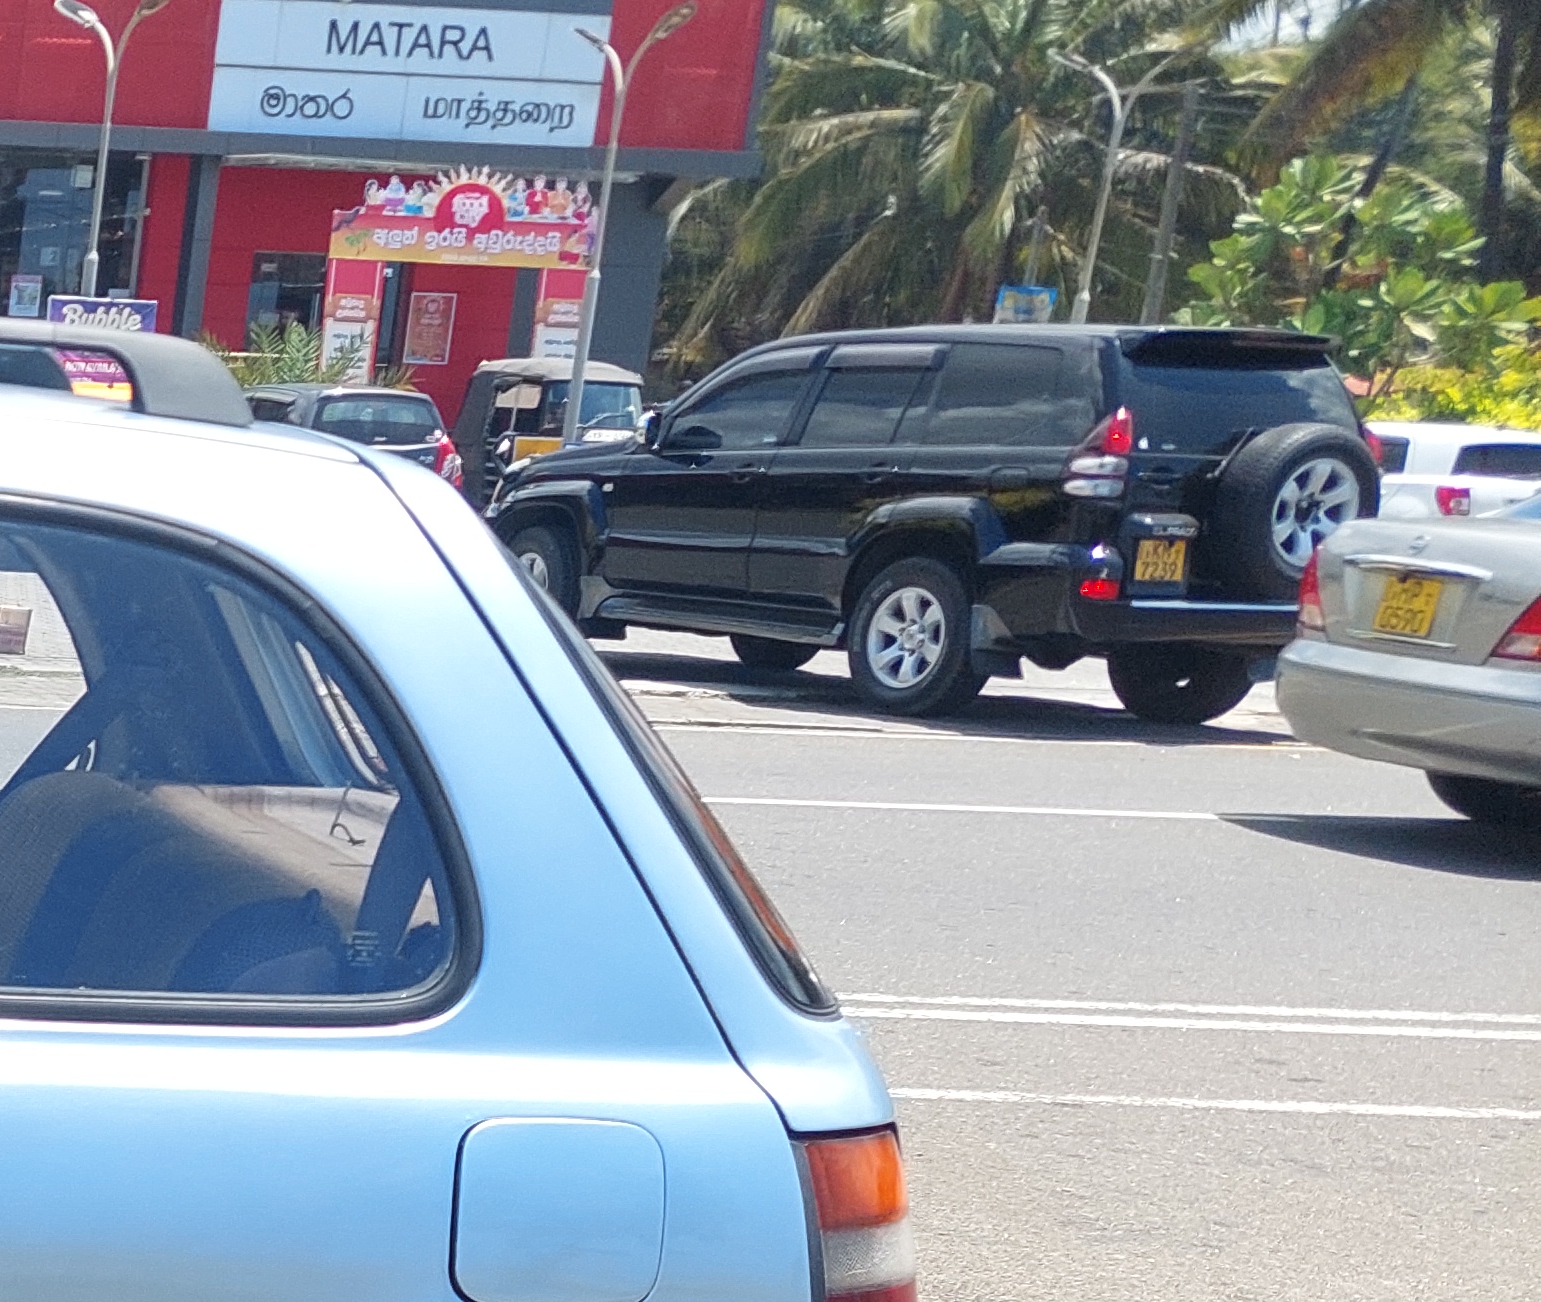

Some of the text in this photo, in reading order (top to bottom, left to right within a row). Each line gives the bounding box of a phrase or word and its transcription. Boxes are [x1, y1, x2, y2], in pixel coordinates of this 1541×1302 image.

[325, 18, 494, 63] MATARA
[260, 85, 355, 121] මාතර
[422, 91, 576, 133] மாத்தறை
[62, 303, 143, 331] Bubble
